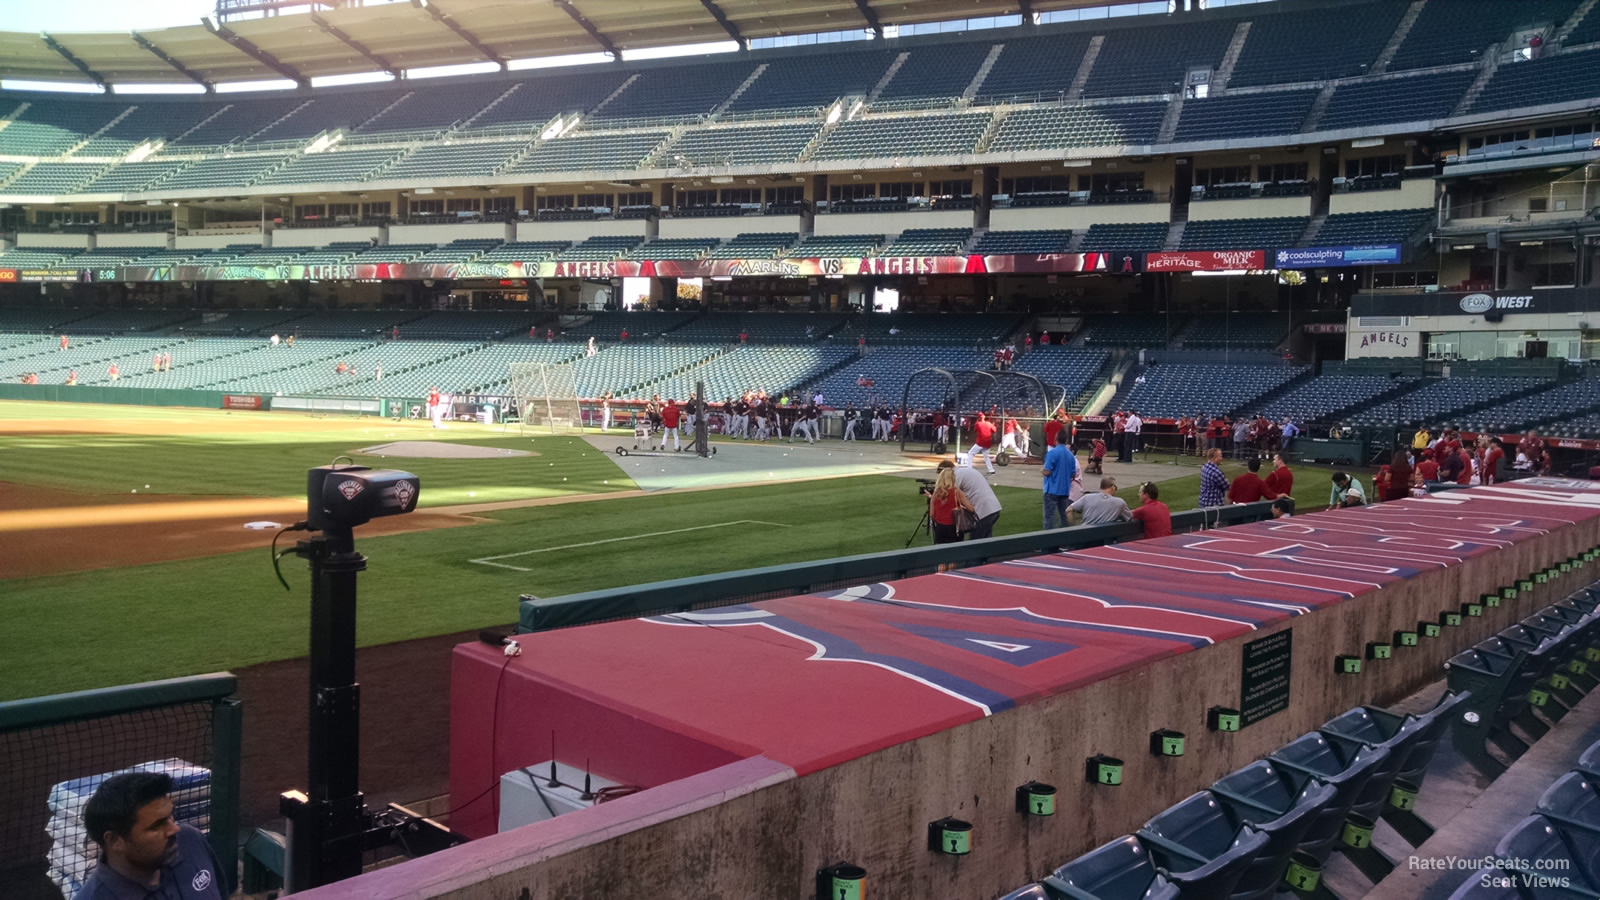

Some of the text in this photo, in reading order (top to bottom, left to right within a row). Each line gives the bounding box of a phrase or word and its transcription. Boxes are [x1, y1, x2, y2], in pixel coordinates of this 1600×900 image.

[1213, 251, 1255, 259] ORGANIC
[1289, 250, 1342, 259] coolsculpting
[455, 263, 509, 278] MARLINS
[524, 262, 538, 276] VS
[554, 262, 615, 277] ANGELS
[738, 260, 799, 275] MARLINS
[823, 259, 839, 274] VS
[859, 257, 934, 274] ANGELS
[1147, 260, 1202, 269] HERITAGE
[100, 270, 115, 279] 5:06
[222, 267, 265, 280] MARLINS
[277, 266, 289, 279] VS
[304, 265, 354, 279] ANGELS
[1468, 296, 1533, 308] FOX WEST
[1360, 332, 1408, 348] ANGELS
